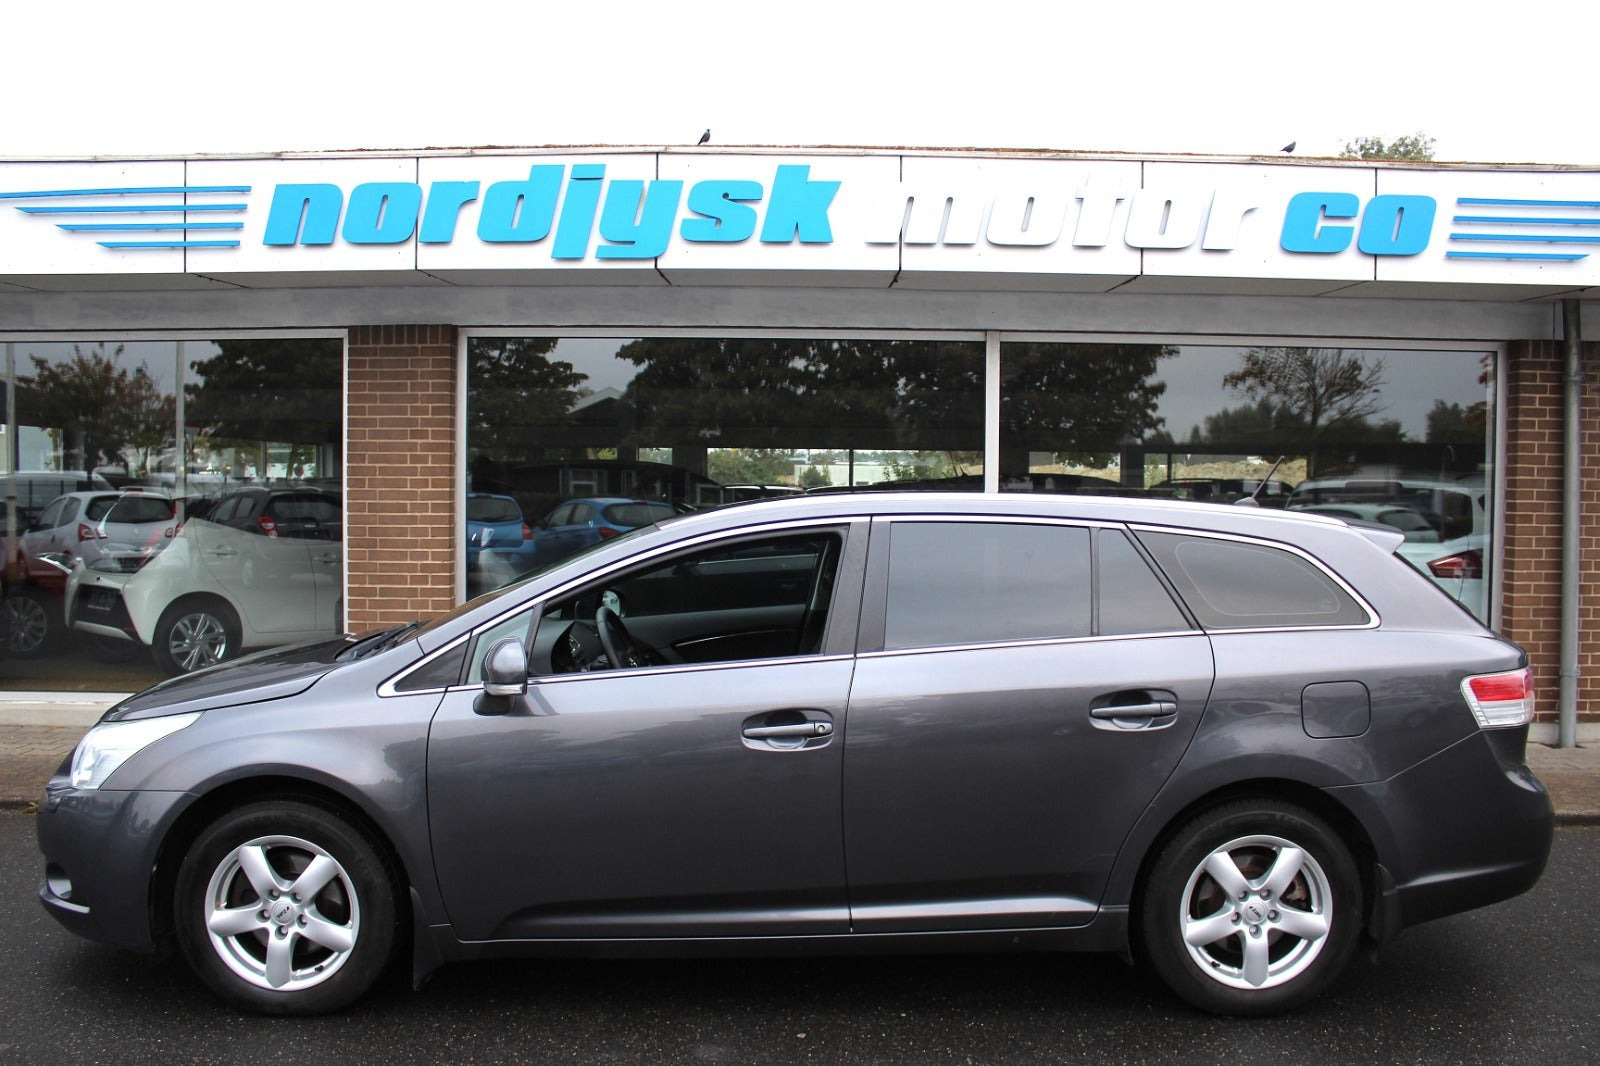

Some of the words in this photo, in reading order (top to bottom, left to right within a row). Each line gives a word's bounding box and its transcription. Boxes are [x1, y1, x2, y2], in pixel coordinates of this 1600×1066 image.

[263, 164, 841, 260] nordjysk
[864, 170, 1261, 251] motor
[1279, 191, 1437, 256] co
